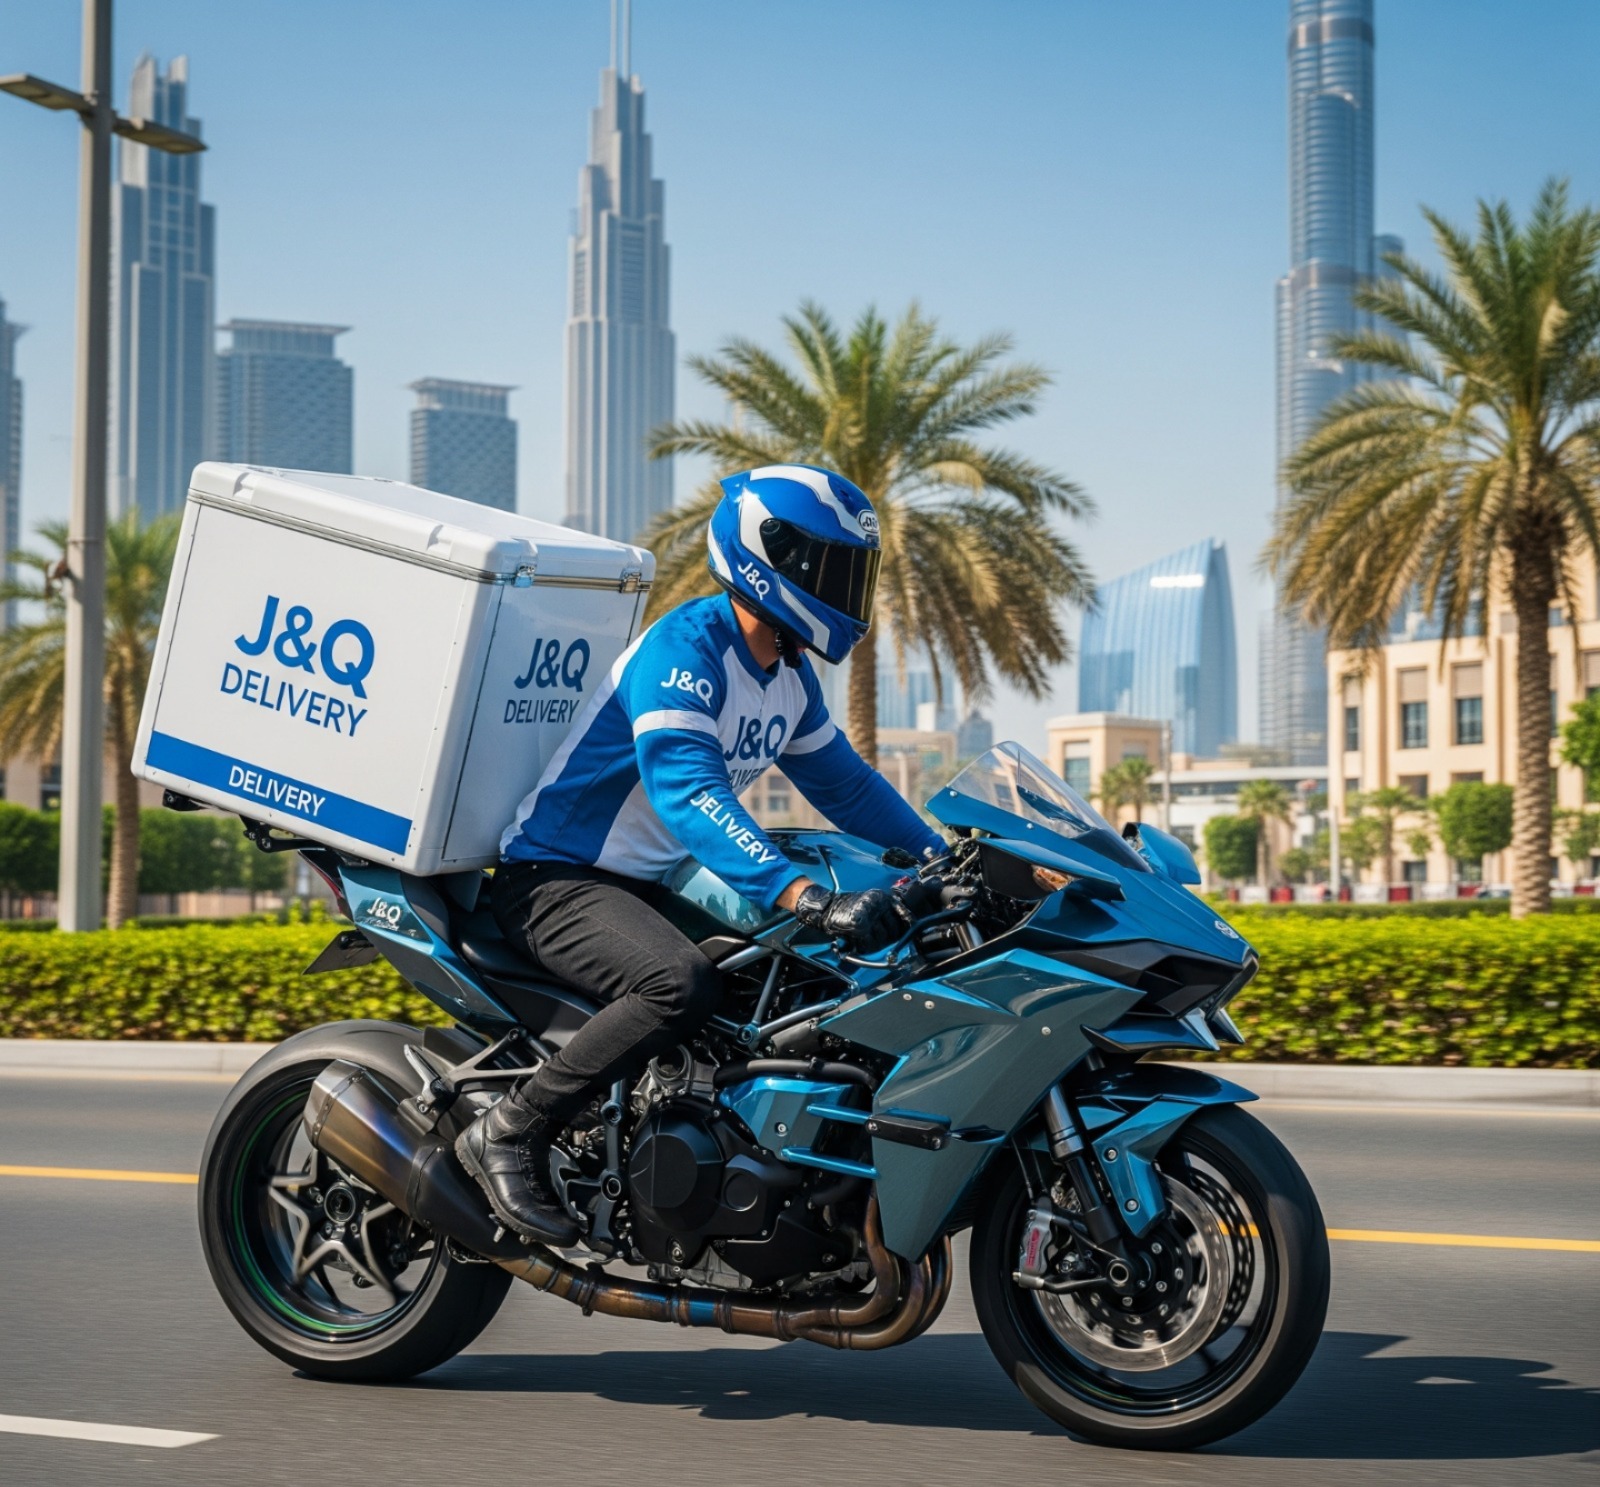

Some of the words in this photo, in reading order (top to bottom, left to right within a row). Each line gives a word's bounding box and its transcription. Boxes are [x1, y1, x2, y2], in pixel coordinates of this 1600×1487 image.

[737, 561, 770, 600] J&Q
[234, 595, 374, 699] J&Q
[514, 638, 590, 692] J&Q
[219, 662, 367, 737] DELIVERY
[503, 699, 580, 723] DELIVERY
[660, 667, 713, 708] J&Q
[724, 714, 787, 761] J&Q
[228, 765, 326, 817] DELIVERY
[690, 791, 778, 864] DELIVERY
[366, 897, 401, 926] J&Q
